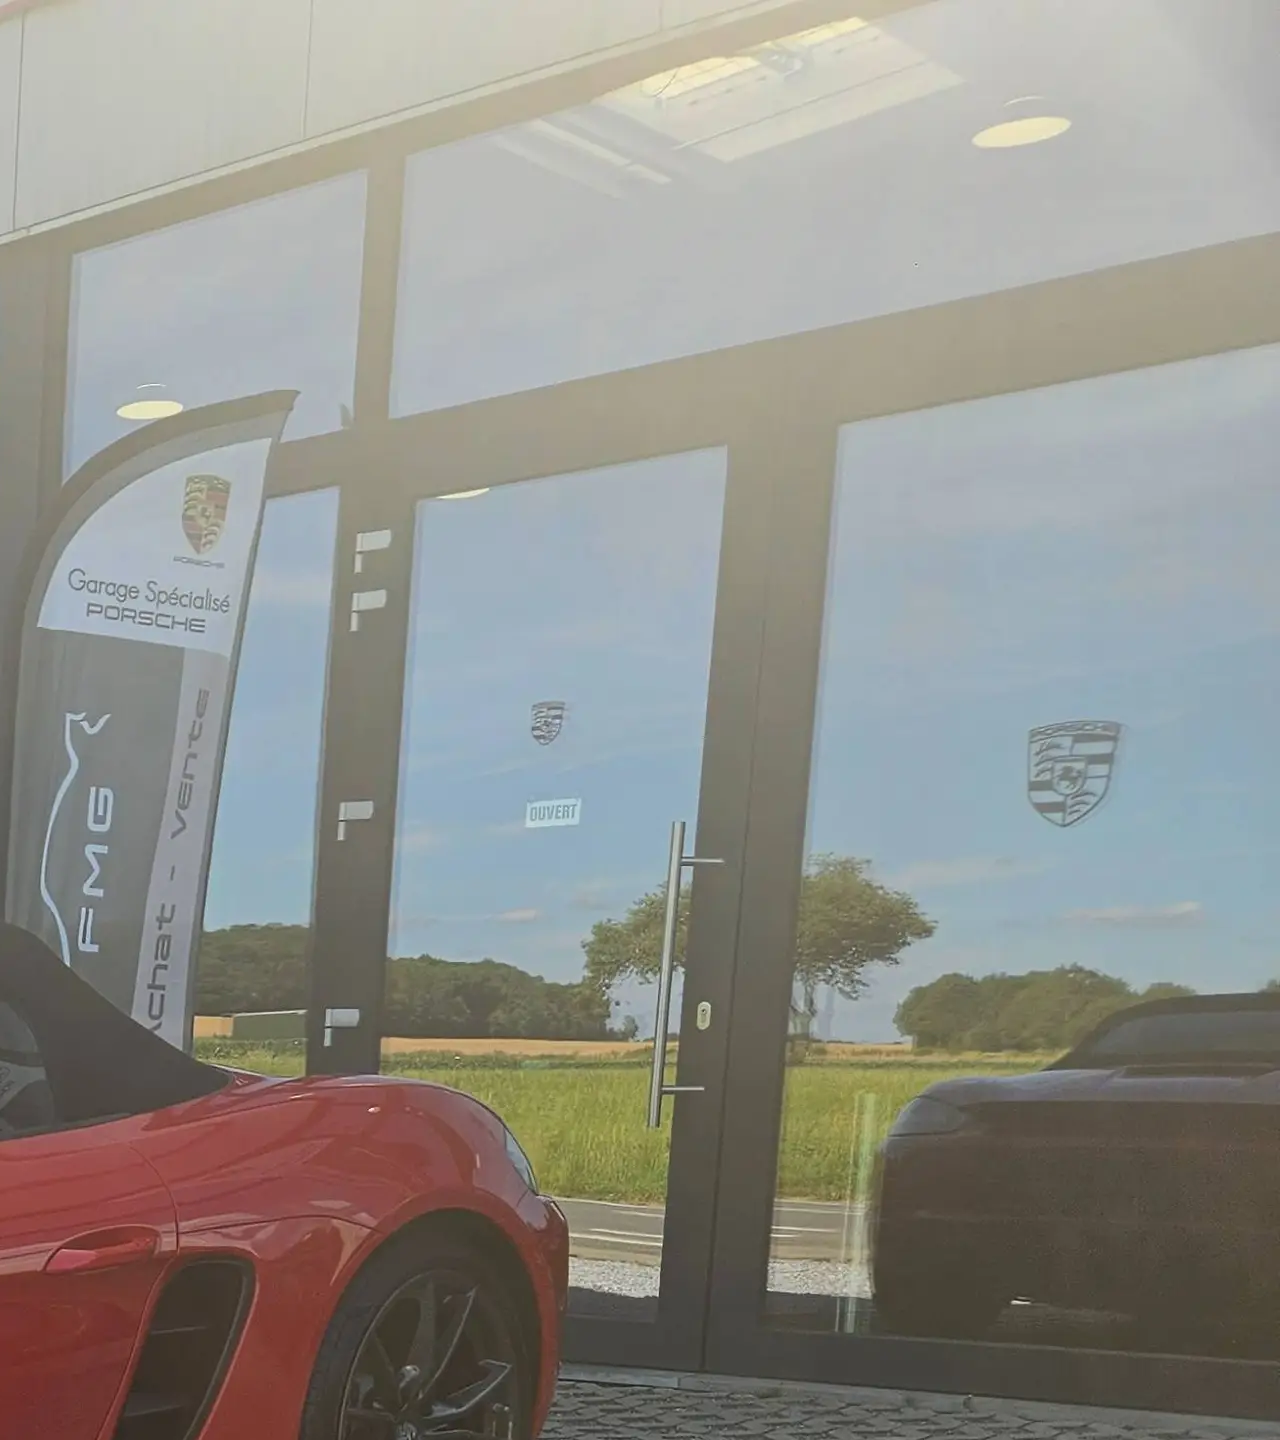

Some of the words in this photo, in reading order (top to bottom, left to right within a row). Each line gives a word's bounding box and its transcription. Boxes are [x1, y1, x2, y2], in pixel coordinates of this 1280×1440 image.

[68, 568, 140, 603] Garage
[144, 580, 230, 614] Spécialisé
[86, 602, 206, 633] PORSCHE
[529, 803, 578, 822] OUVERT
[77, 785, 115, 953] FMG
